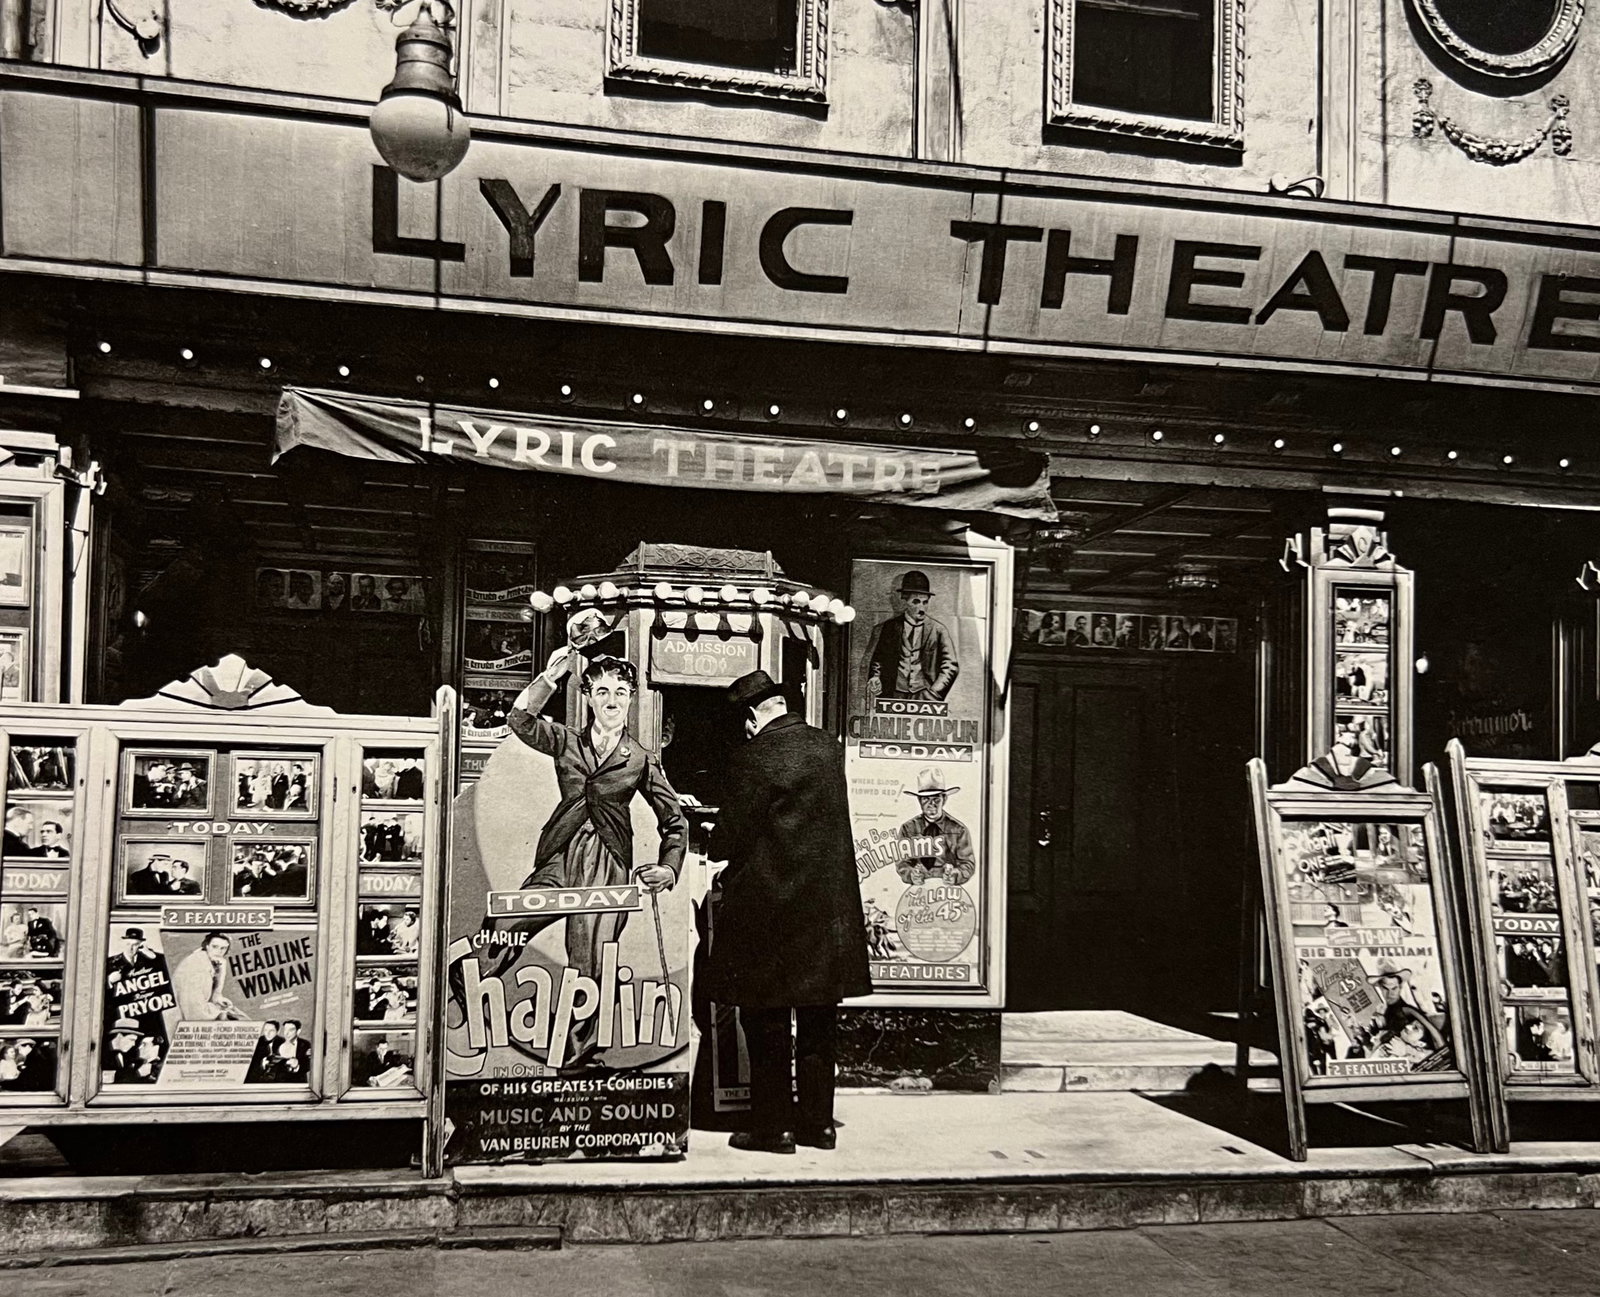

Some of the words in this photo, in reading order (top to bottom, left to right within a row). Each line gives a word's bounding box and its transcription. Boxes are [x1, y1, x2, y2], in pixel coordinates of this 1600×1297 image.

[373, 164, 854, 294] LYRIC
[950, 220, 1600, 353] THEATRE
[418, 416, 618, 475] LYRIC
[653, 438, 941, 494] THEATRE
[663, 640, 747, 657] ADMISSION
[681, 653, 728, 676] 10¢
[878, 701, 947, 715] TODAY
[848, 715, 912, 740] CHARLIE
[913, 717, 979, 743] CHAPLIN
[865, 743, 968, 760] TO-DAY
[172, 821, 270, 834] TODAY
[854, 837, 872, 854] ig
[868, 827, 900, 845] Boy
[6, 872, 63, 889] TODAY
[363, 875, 416, 892] TODAY
[497, 889, 633, 911] TO-DAY
[927, 886, 962, 904] LAW
[168, 911, 178, 924] 2
[185, 911, 267, 924] FEATURES
[1493, 918, 1560, 932] TODAY
[238, 932, 262, 949] THE
[472, 929, 529, 949] CHARLIE
[1356, 929, 1400, 945] TO-DAY
[228, 936, 313, 978] HEADLINE
[1301, 947, 1326, 957] BIG
[1333, 946, 1361, 957] BOY
[1366, 946, 1434, 957] WILLIAMS
[237, 961, 312, 999] WOMAN
[879, 965, 966, 980] FEATURES
[115, 971, 170, 997] ANGEL
[119, 993, 175, 1019] PRYOR
[493, 1066, 509, 1078] IN
[511, 1064, 544, 1077] ONE
[1333, 1066, 1341, 1076] 2
[1345, 1062, 1406, 1076] FEATURES
[480, 1083, 499, 1096] OF
[503, 1082, 527, 1095] HIS
[480, 1107, 544, 1125] MUSIC
[549, 1106, 592, 1122] AND
[600, 1103, 676, 1121] SOUND
[559, 1125, 571, 1133] BY
[573, 1123, 591, 1132] THE
[480, 1138, 510, 1152] VAN
[514, 1135, 570, 1150] BEUREN
[575, 1131, 677, 1148] CORPORATION
